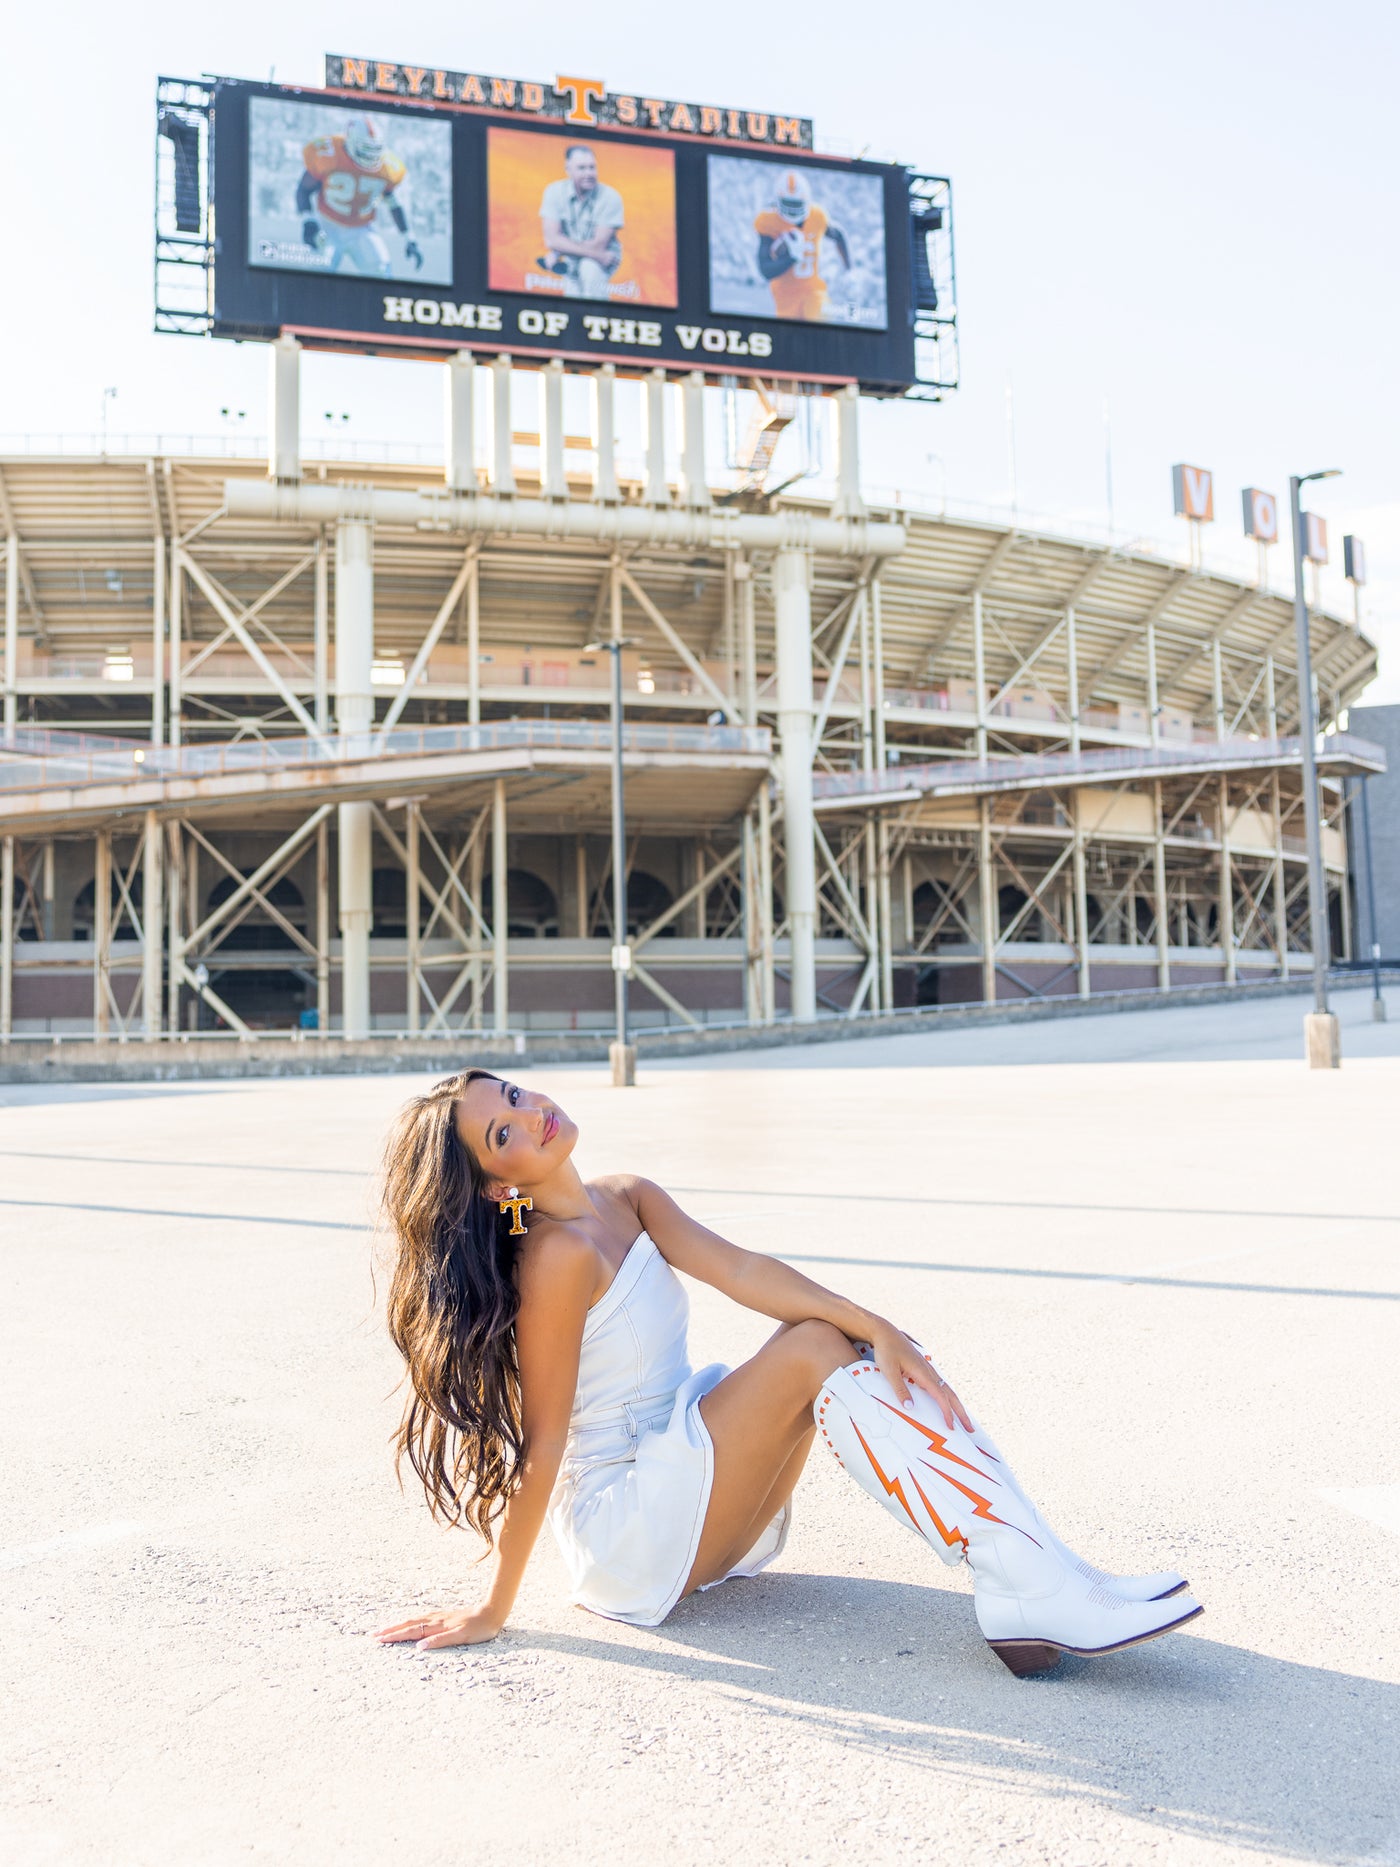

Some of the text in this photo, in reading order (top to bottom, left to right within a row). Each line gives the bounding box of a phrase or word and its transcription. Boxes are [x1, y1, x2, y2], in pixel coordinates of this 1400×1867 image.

[342, 58, 801, 142] NEYLAND T STADIUM
[325, 172, 387, 216] 27
[384, 297, 773, 357] HOME OF THE VOLS
[500, 1197, 533, 1235] T
